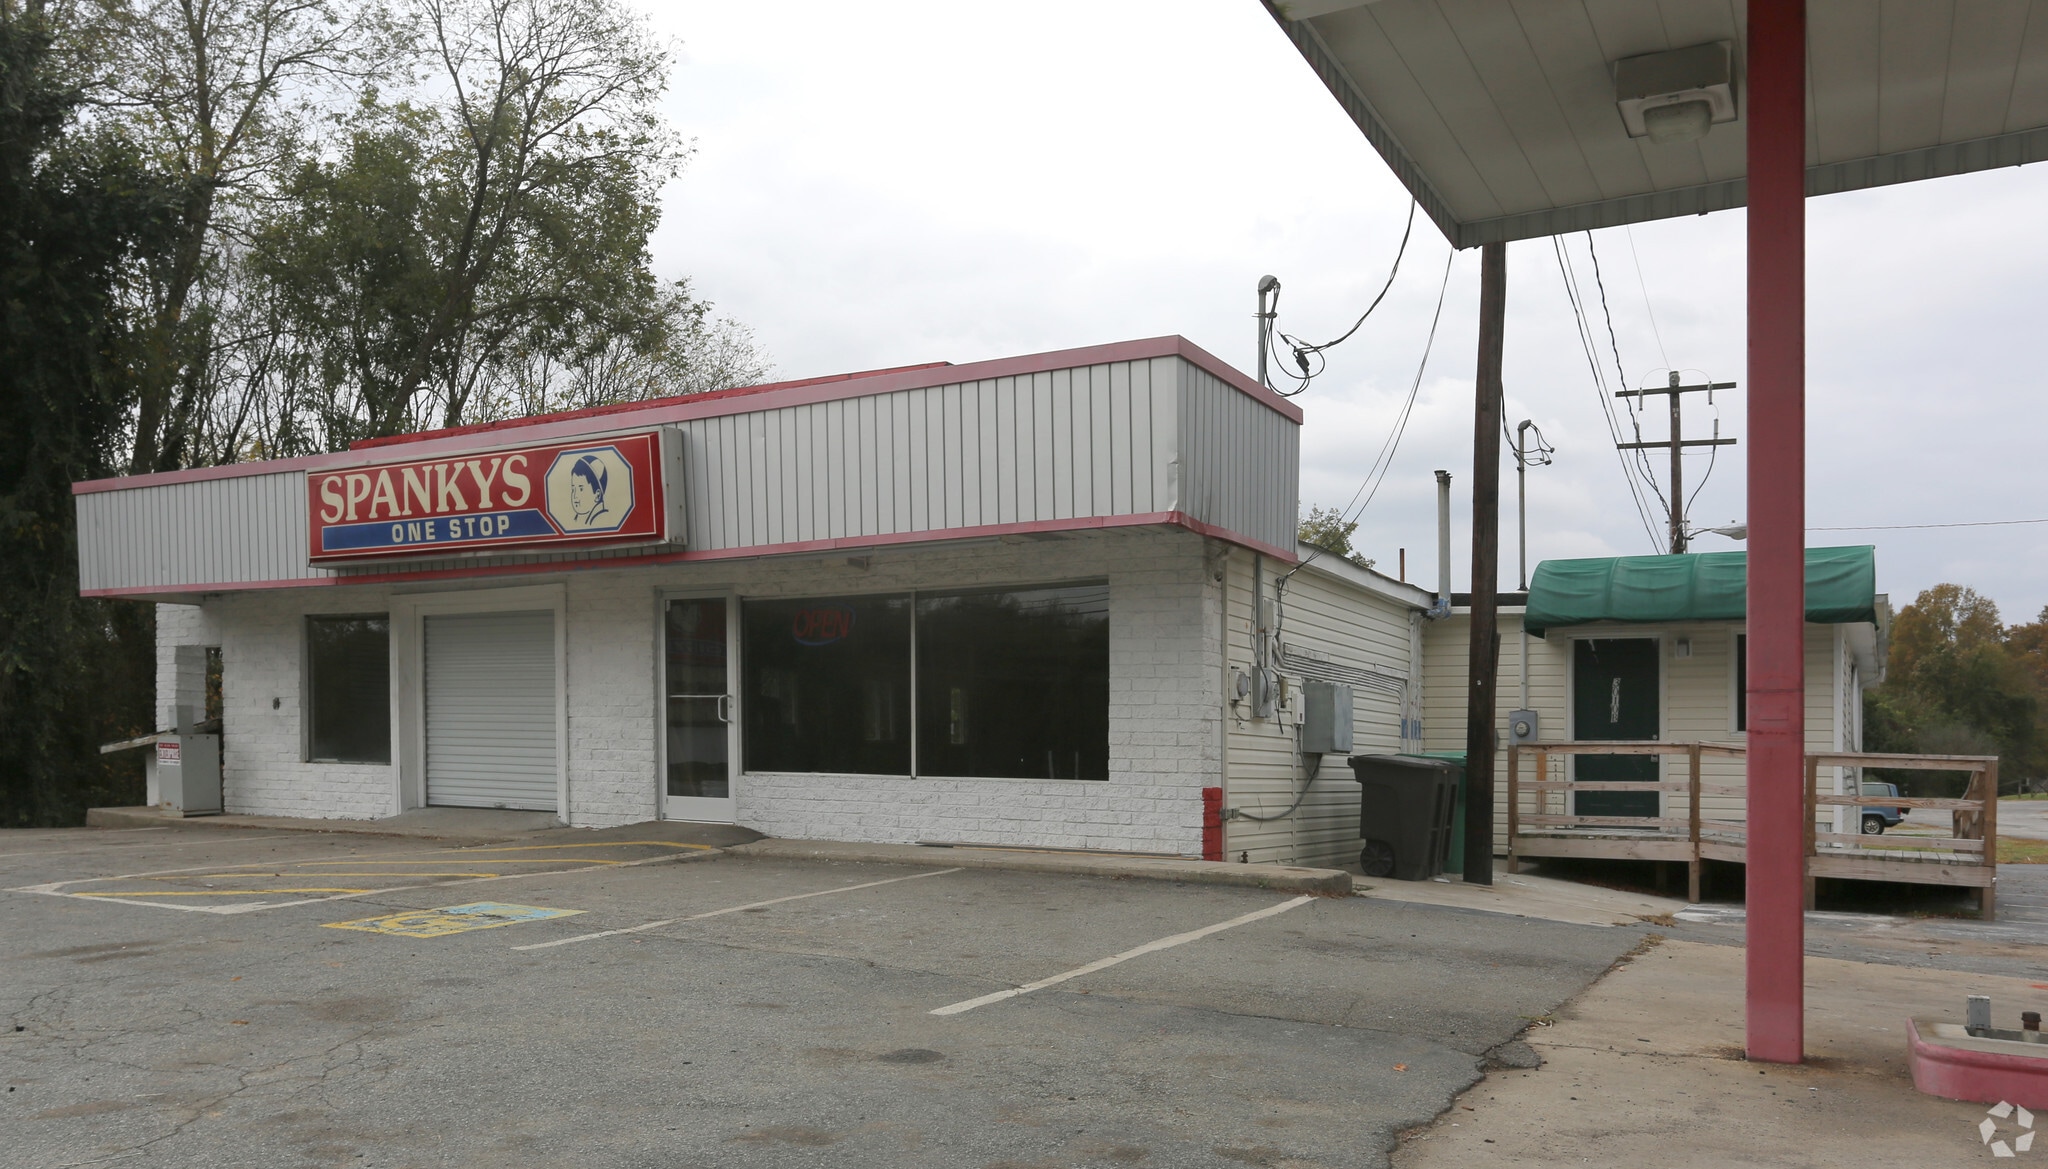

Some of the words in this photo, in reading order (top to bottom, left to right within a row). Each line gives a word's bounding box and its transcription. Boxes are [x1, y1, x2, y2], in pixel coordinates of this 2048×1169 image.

[320, 455, 531, 524] SPANKYS
[391, 520, 436, 543] ONE
[449, 514, 510, 539] STOP
[792, 608, 851, 639] OPEN
